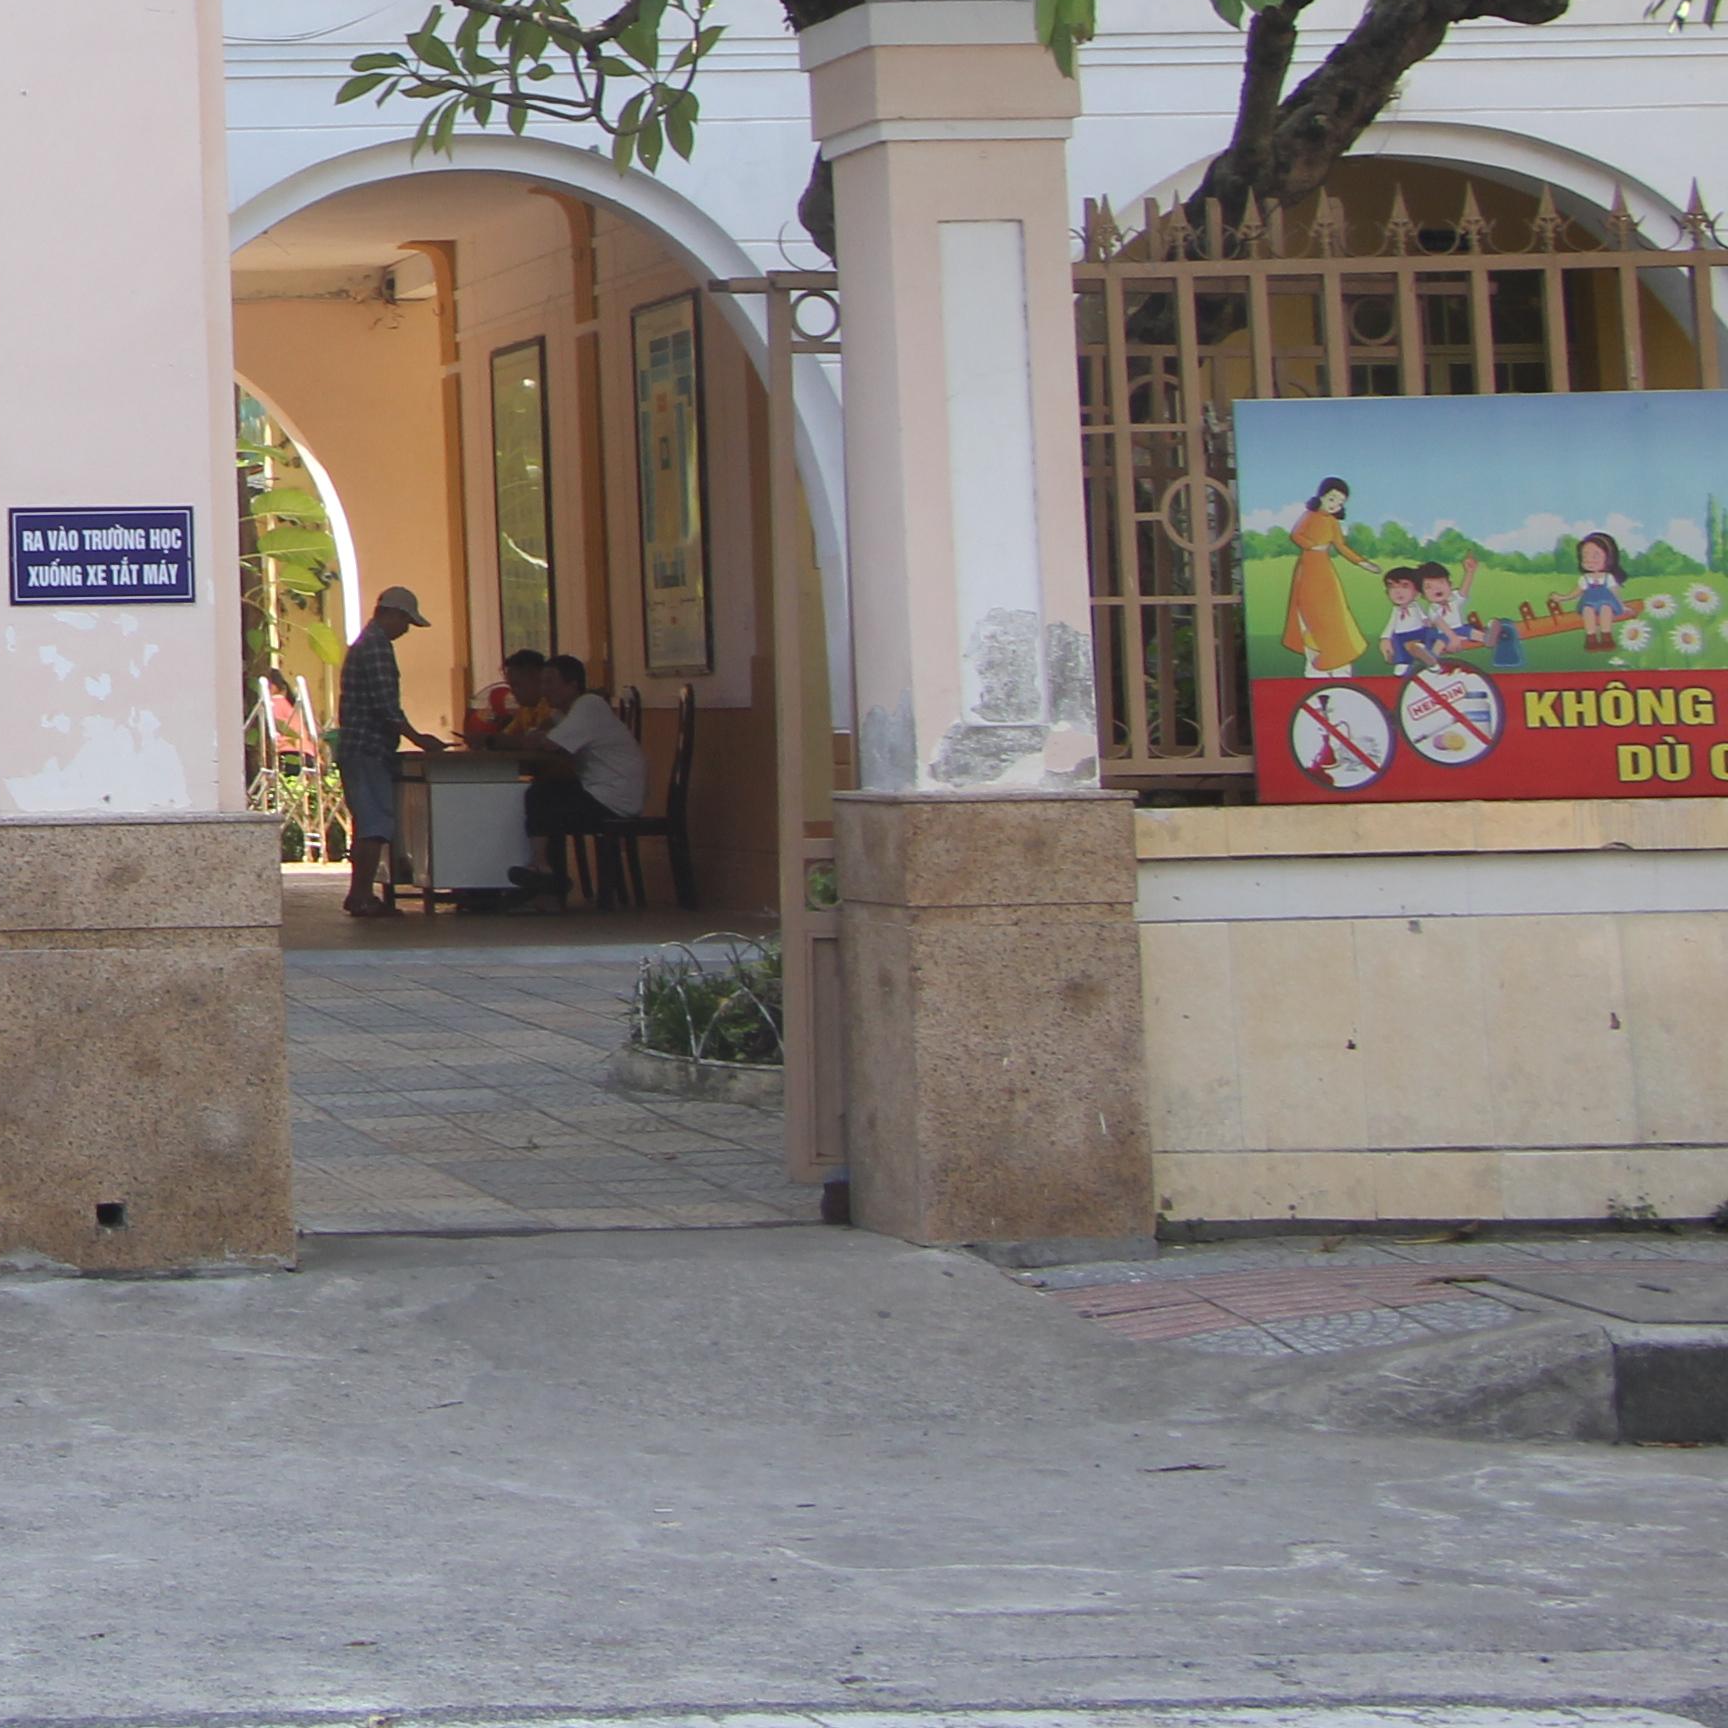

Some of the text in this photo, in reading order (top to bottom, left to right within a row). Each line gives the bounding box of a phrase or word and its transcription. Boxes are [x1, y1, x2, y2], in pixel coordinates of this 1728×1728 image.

[22, 524, 182, 554] RA VÀO TRƯỜNG HỌC
[27, 556, 179, 587] XUỐNG XE TẮT MÁY
[1524, 680, 1716, 729] KHÔNG
[1616, 735, 1692, 783] DÙ
